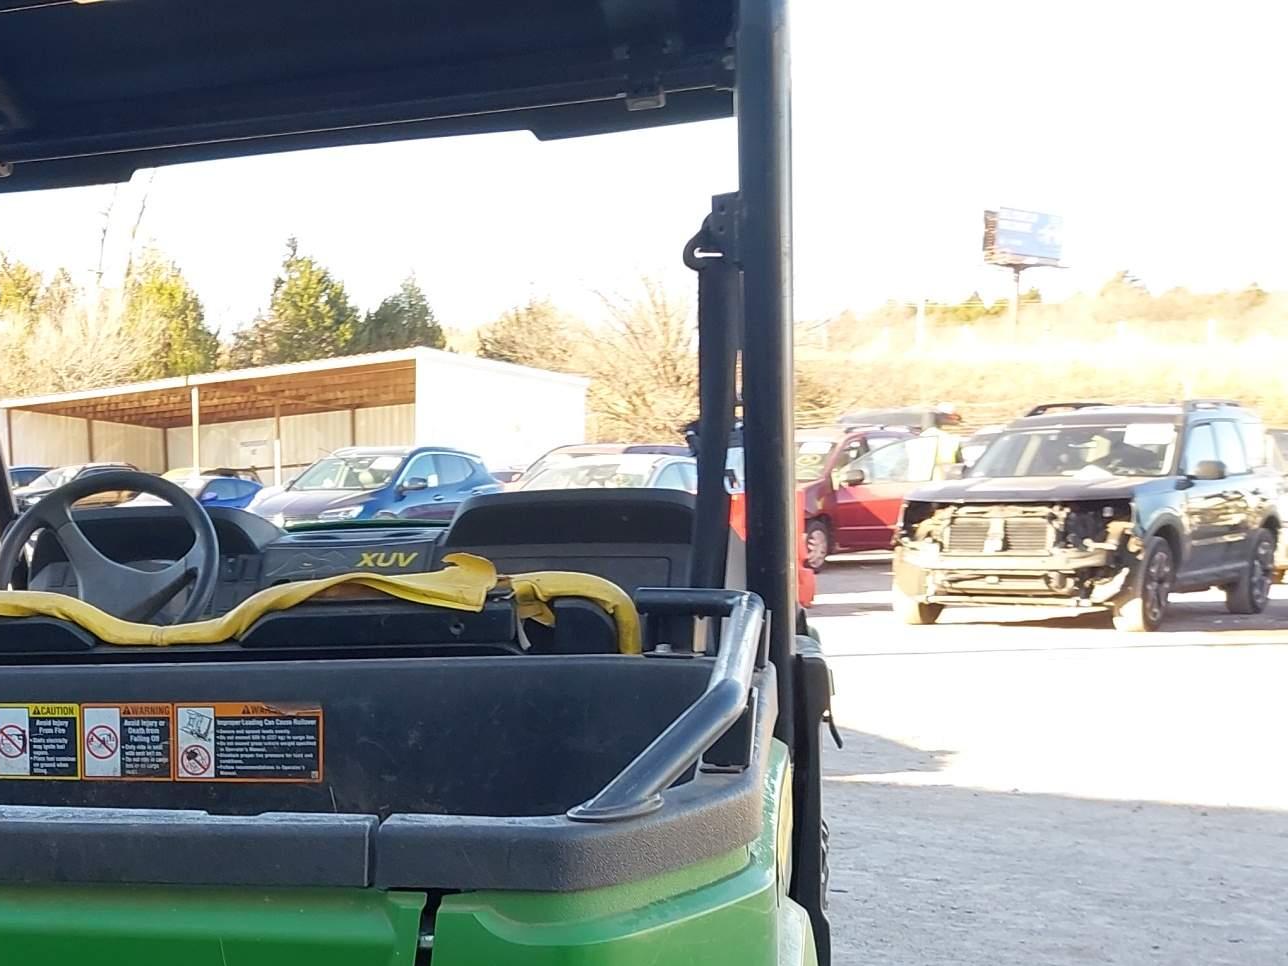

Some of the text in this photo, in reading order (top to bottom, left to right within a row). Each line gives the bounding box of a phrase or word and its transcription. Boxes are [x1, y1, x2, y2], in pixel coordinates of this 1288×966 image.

[355, 552, 419, 567] XUV
[40, 706, 74, 716] CAUTION
[131, 706, 170, 716] WARNING
